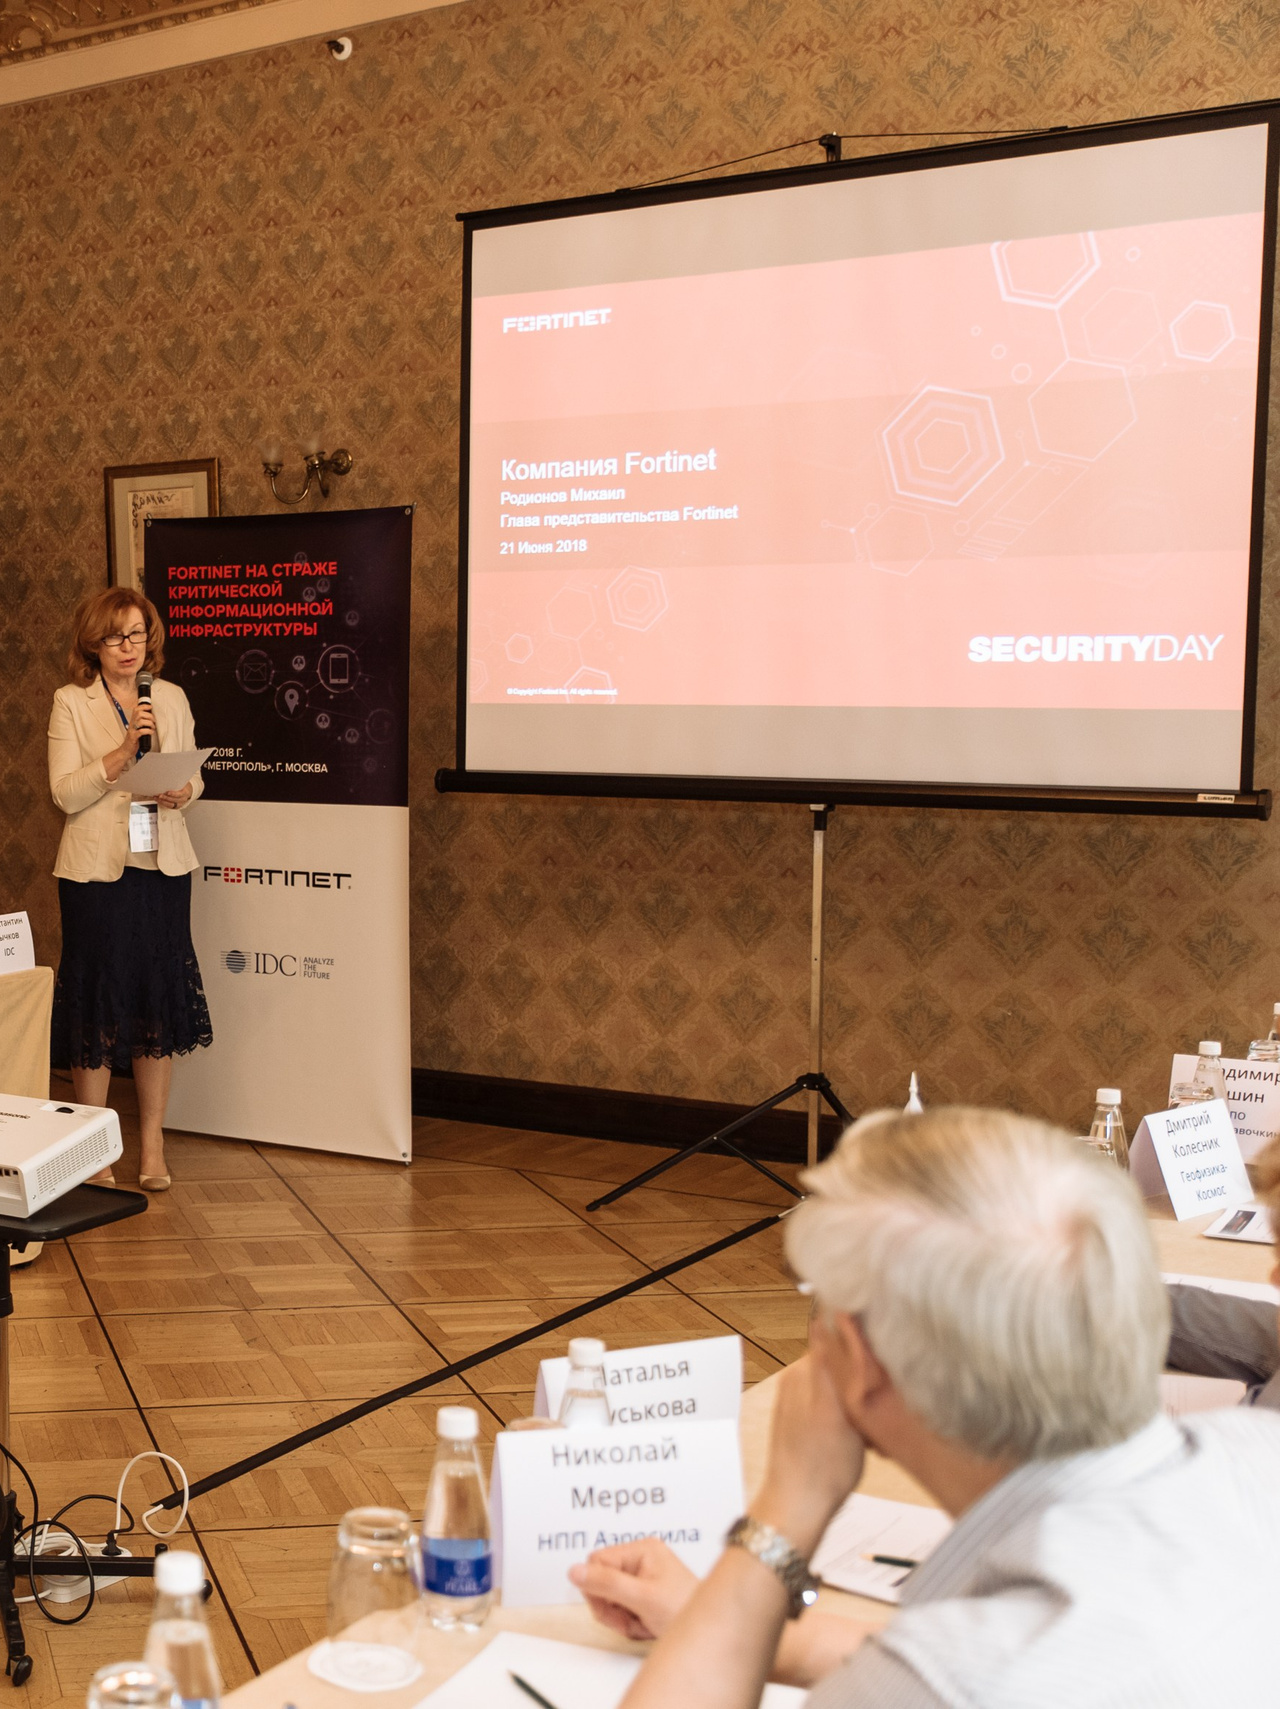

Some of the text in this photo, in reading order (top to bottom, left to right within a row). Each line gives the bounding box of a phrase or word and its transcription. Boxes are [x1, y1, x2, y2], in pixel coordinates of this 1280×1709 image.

[503, 307, 612, 334] FORTINET
[501, 448, 717, 481] Компания Fortinet
[500, 488, 626, 506] Родионов Михаил
[500, 504, 739, 528] Глава представительства Fortinet
[499, 539, 587, 554] 21 Июня 2018
[168, 562, 338, 580] FORTINET НА СТРАЖЕ
[169, 580, 283, 599] КРИТИЧЕСКОЙ
[169, 599, 333, 619] ИНФОРМАЦИОННОЙ
[169, 622, 318, 637] ИНФРАСТРУКТУРЫ
[968, 634, 1225, 662] SECURITYDAY
[213, 748, 234, 757] 2018
[285, 763, 328, 773] МОСКВА
[204, 866, 352, 889] FORTINET
[4, 947, 16, 956] IDC
[254, 952, 297, 976] IDC
[303, 957, 335, 966] ANALYZE
[303, 972, 331, 980] FUTURE
[1165, 1110, 1211, 1136] Дмитрий
[1172, 1138, 1221, 1158] Колесник
[1180, 1164, 1228, 1183] Геофизика-
[1196, 1186, 1227, 1201] Космос
[551, 1436, 678, 1467] Николай
[571, 1486, 667, 1514] Меров
[537, 1531, 587, 1551] НПП
